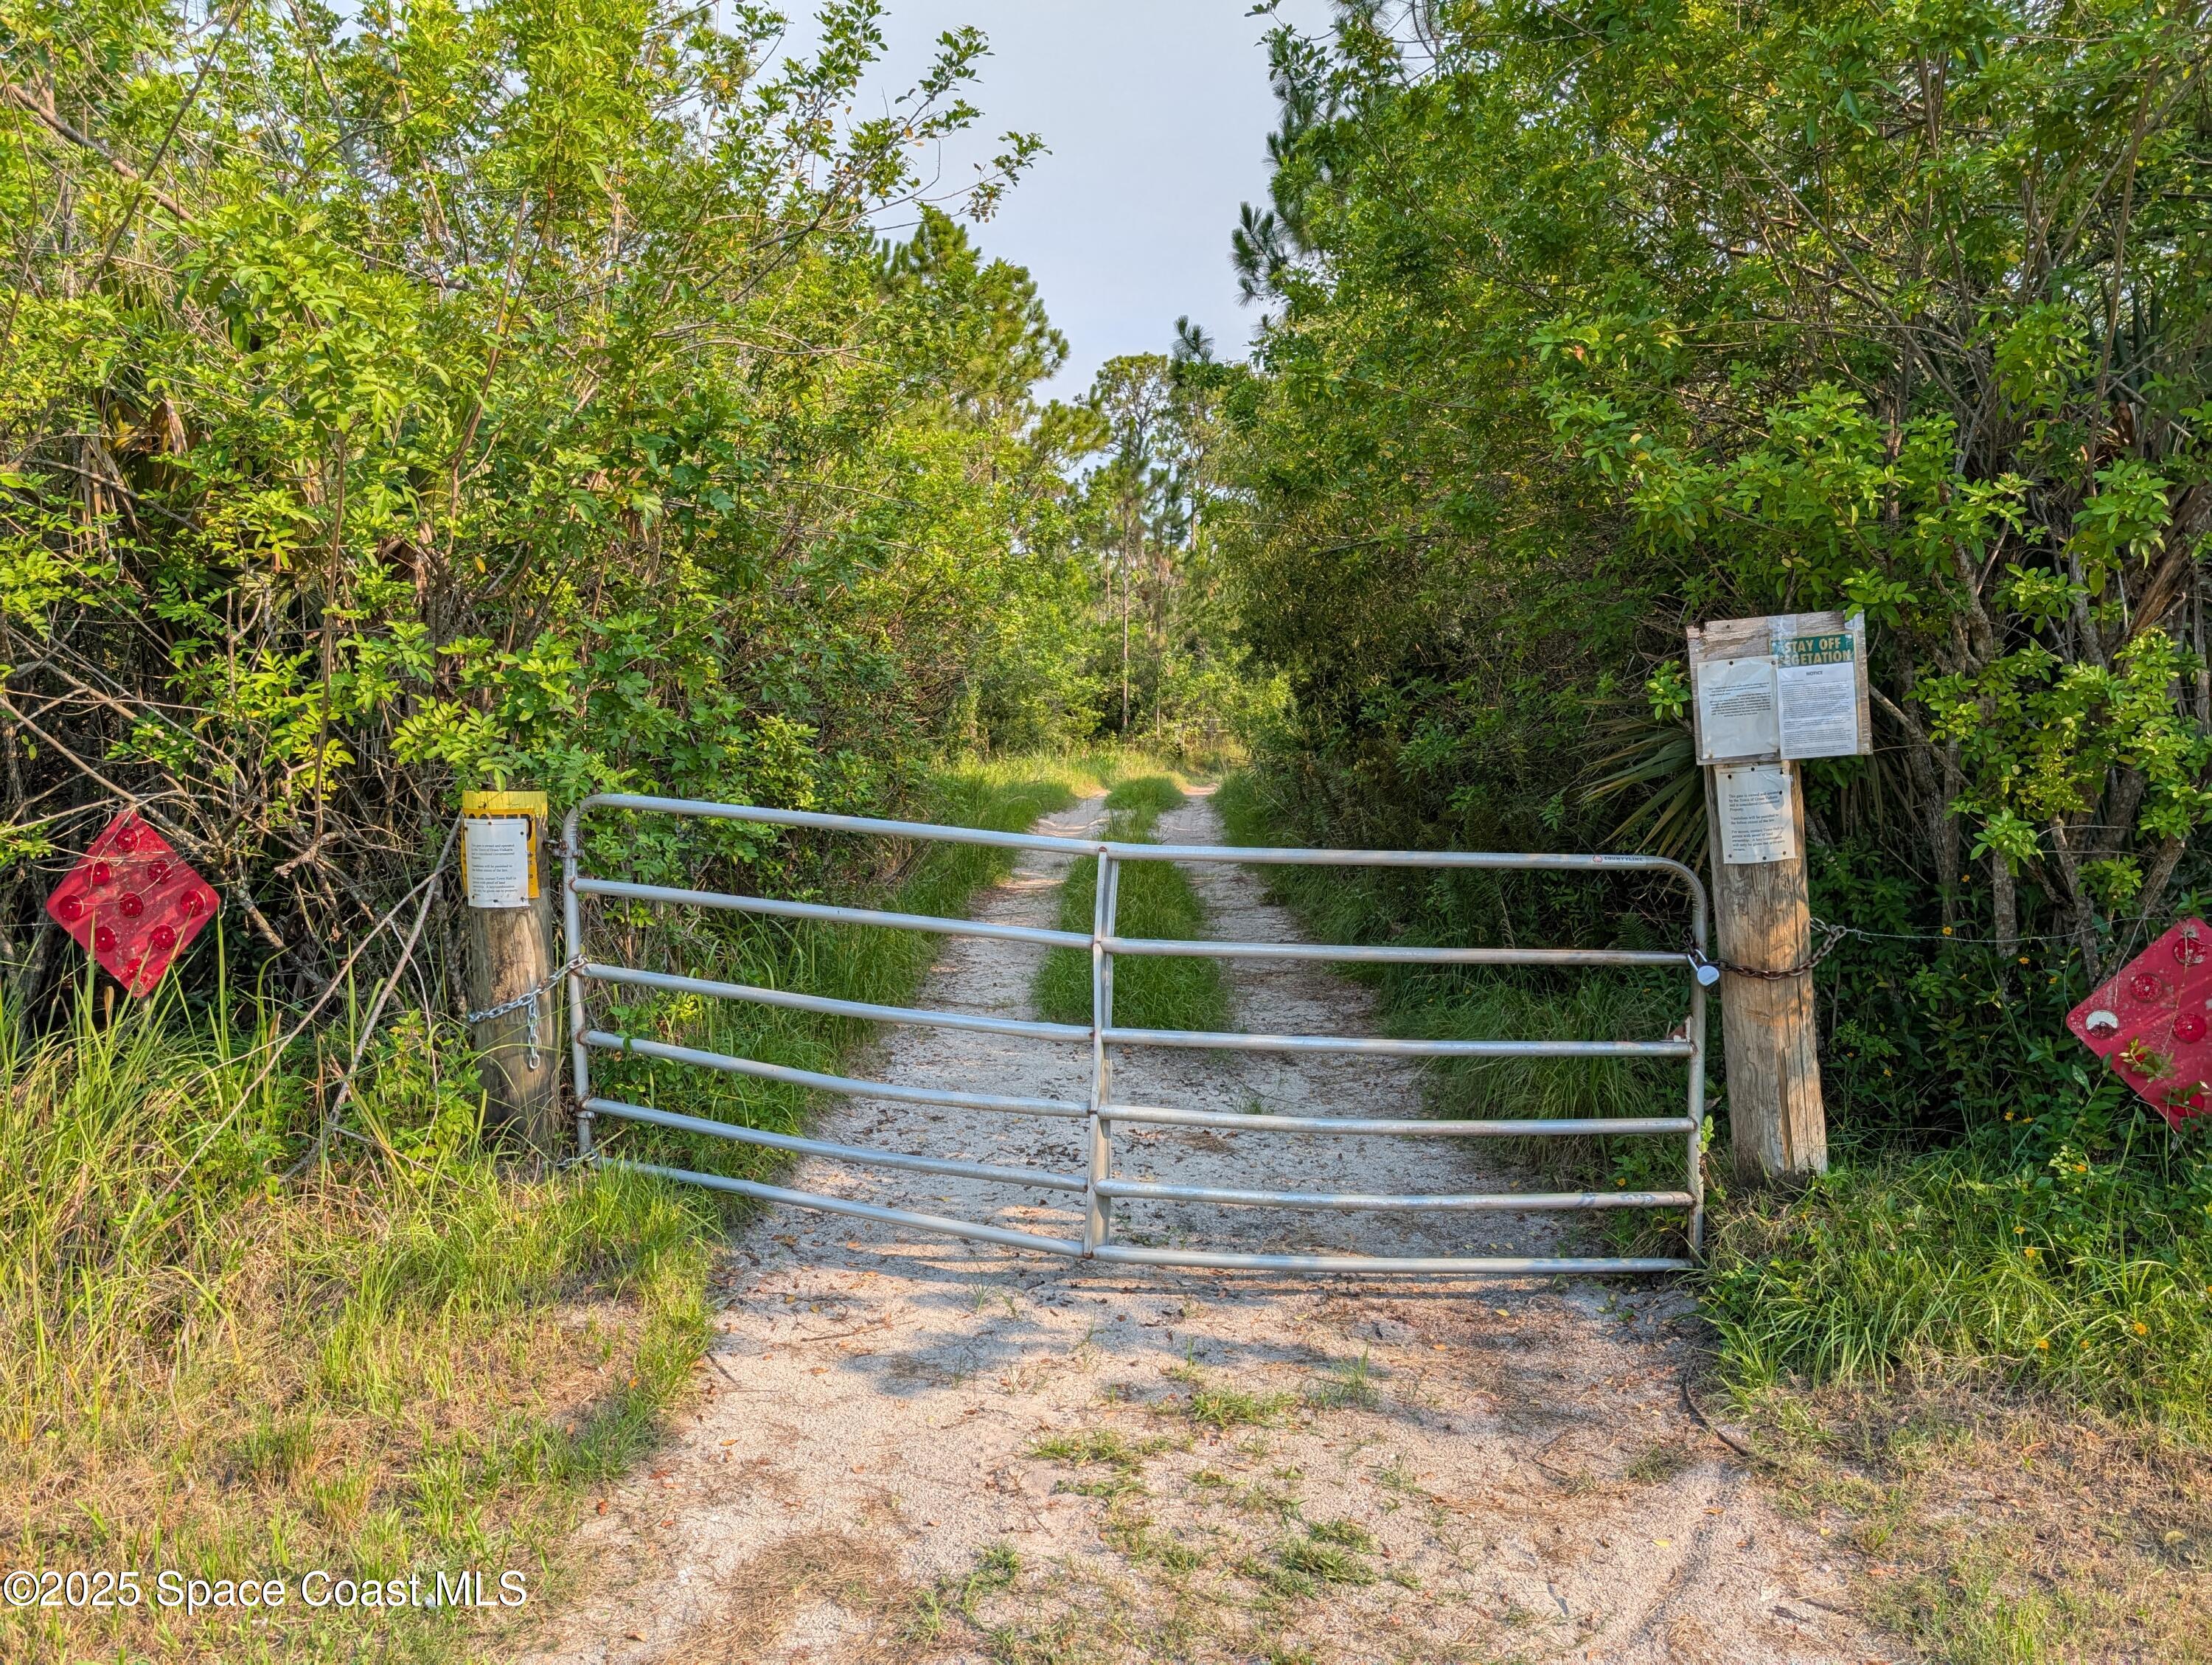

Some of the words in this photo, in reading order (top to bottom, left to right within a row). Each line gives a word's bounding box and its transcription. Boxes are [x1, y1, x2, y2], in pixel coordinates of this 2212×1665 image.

[1784, 639, 1814, 653] STAY
[1819, 637, 1840, 650] OFF
[1779, 650, 1852, 666] EGETATION
